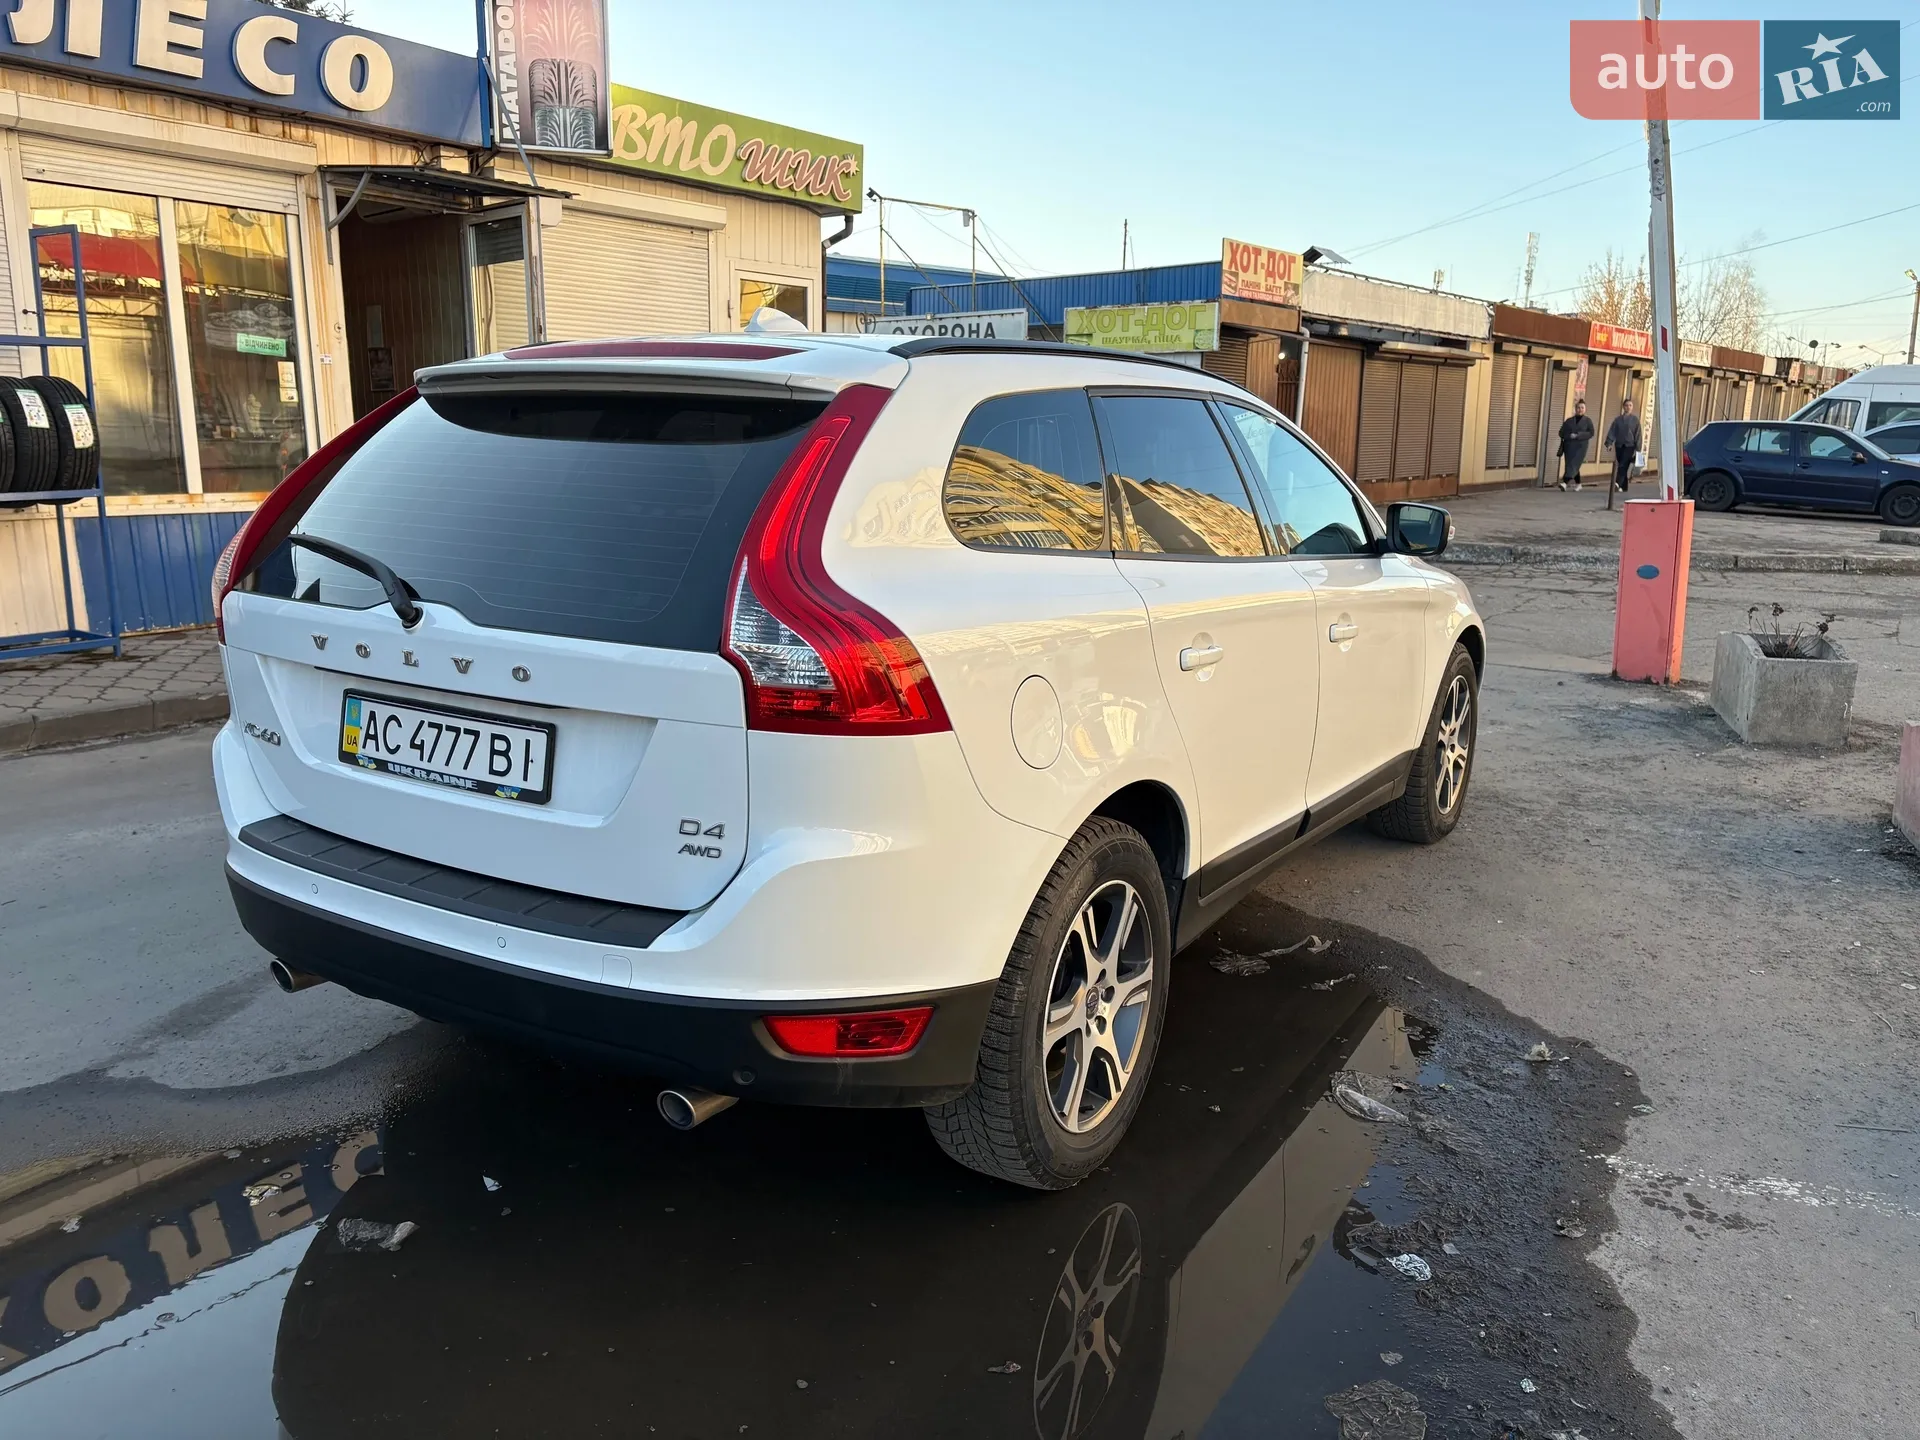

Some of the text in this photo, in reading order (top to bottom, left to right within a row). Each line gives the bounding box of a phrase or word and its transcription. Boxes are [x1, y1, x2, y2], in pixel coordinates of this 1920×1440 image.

[1227, 241, 1297, 285] ХОТ-ДОГ
[1075, 304, 1207, 337] ХОТ-ДОГ
[311, 632, 532, 683] VOLVO
[243, 720, 281, 747] XC60
[346, 734, 358, 747] UA
[361, 709, 403, 755] AC
[409, 719, 481, 771] 4777
[387, 762, 480, 791] UKRAINE
[679, 816, 726, 840] D4
[677, 843, 722, 859] AWD
